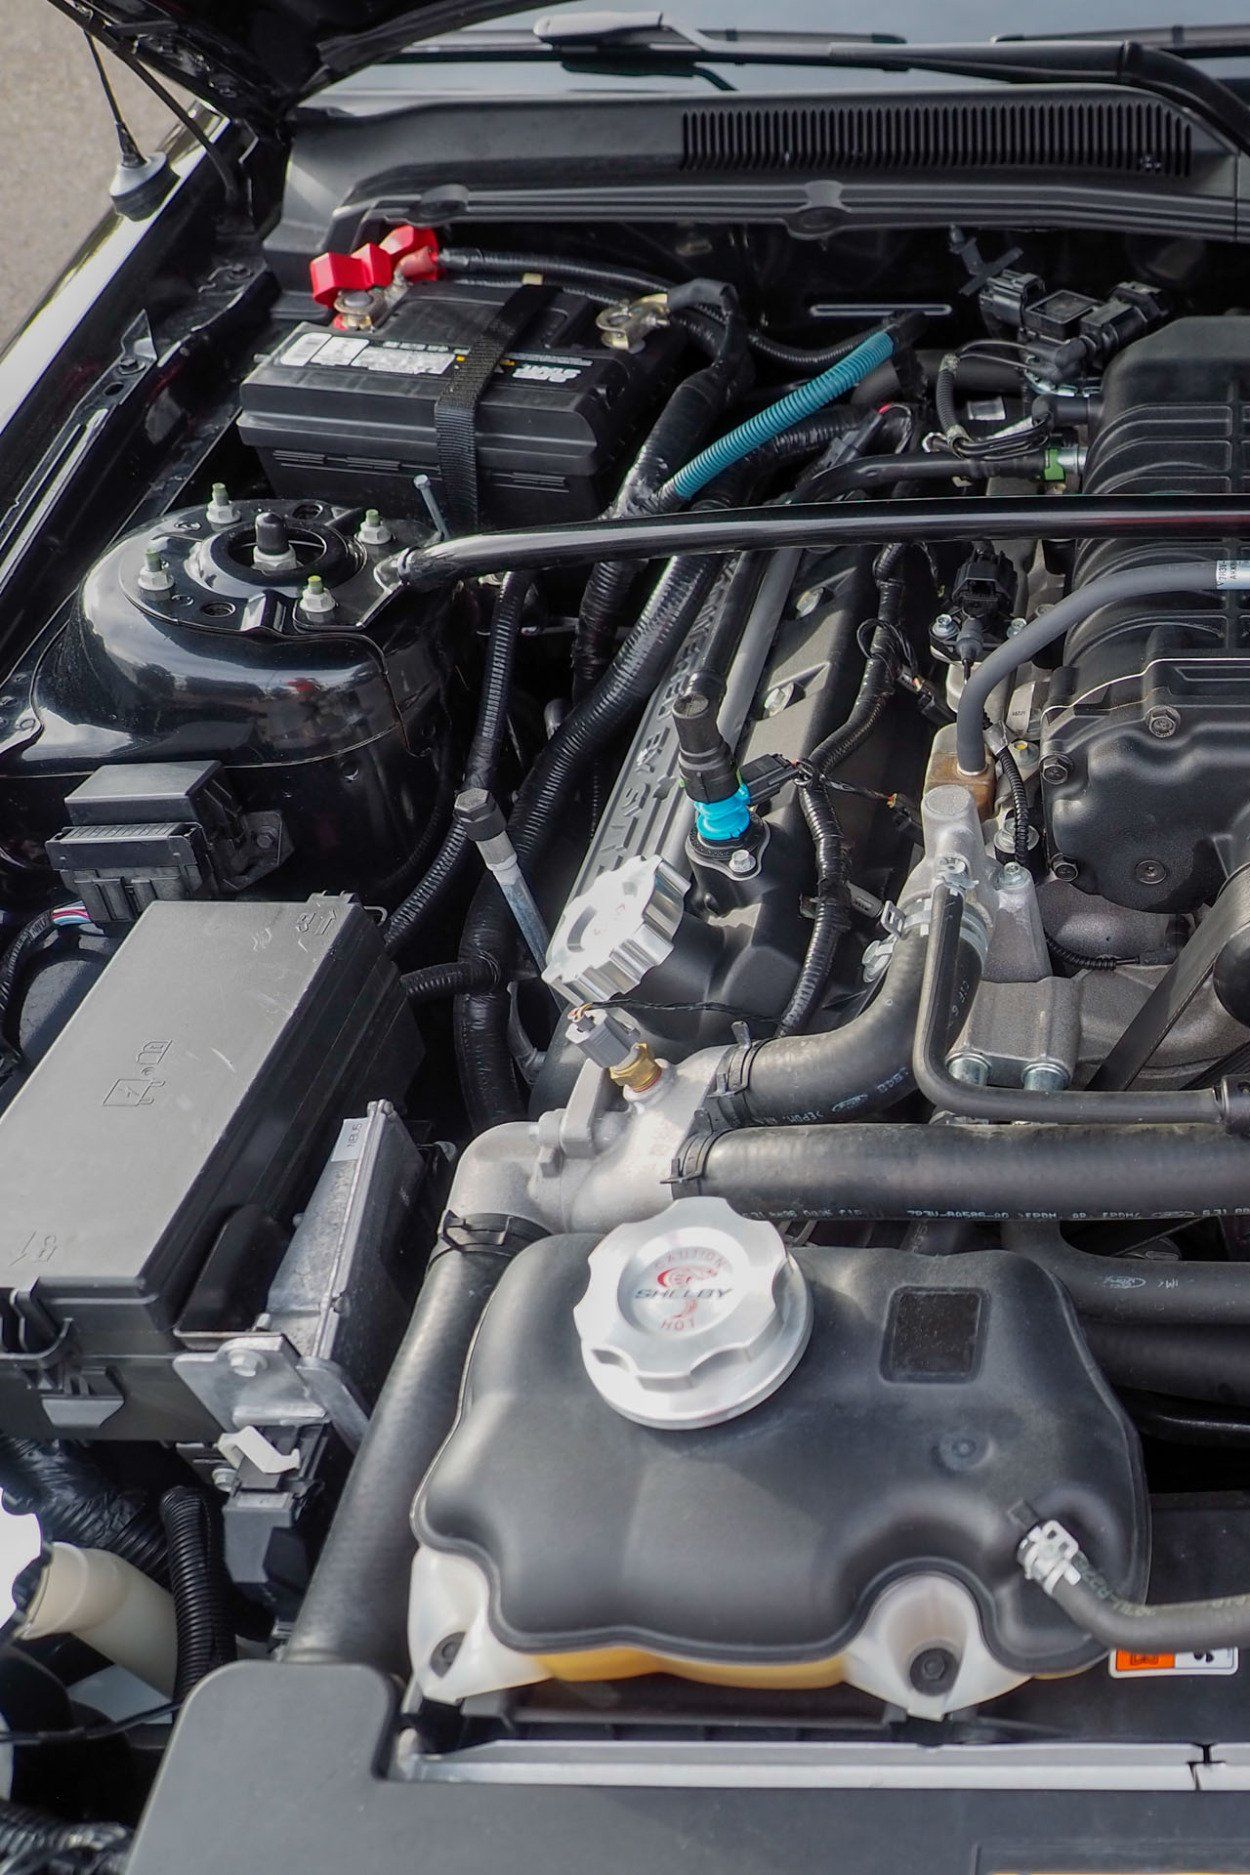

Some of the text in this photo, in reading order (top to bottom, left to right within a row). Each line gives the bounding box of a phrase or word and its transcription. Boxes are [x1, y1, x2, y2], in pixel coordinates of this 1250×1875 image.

[653, 1249, 729, 1269] CAUTION
[634, 1288, 732, 1299] SHELBY
[660, 1318, 695, 1331] HOT
